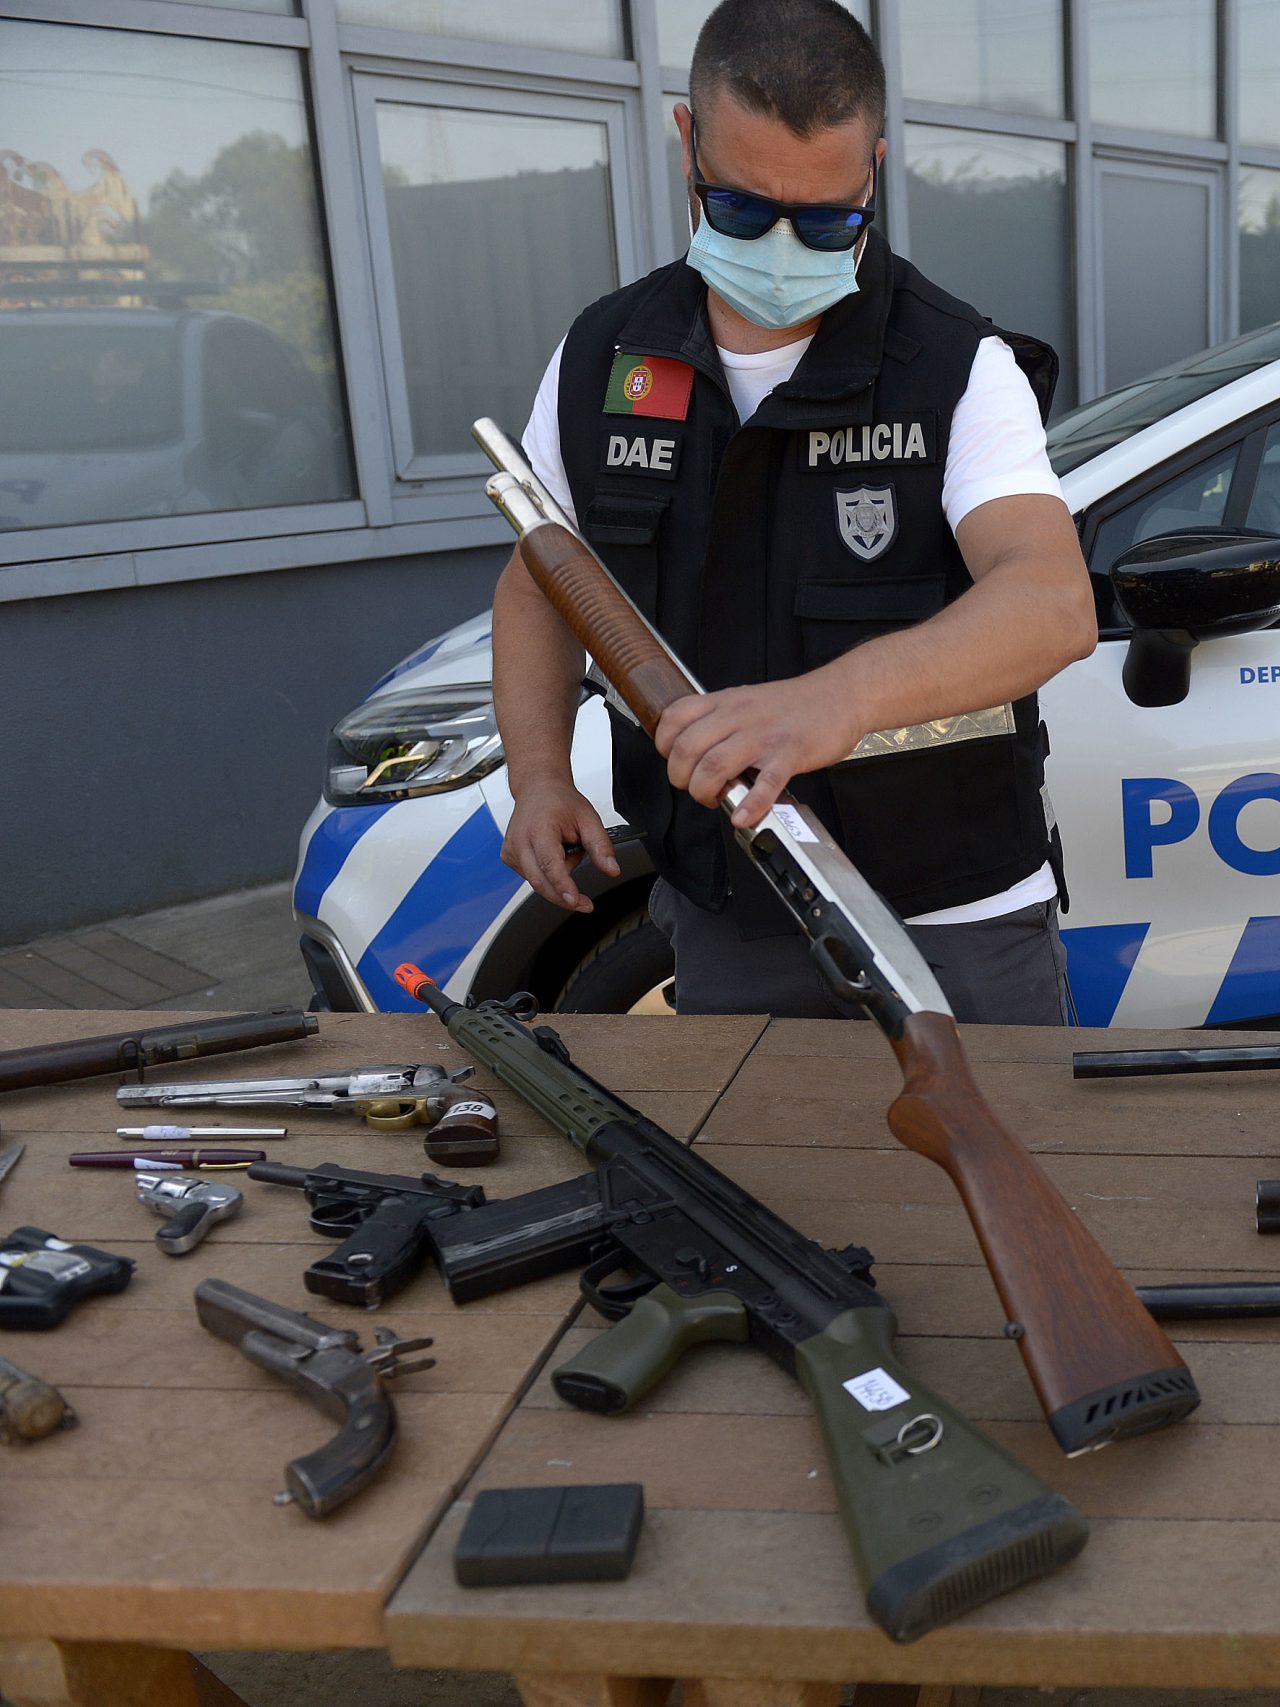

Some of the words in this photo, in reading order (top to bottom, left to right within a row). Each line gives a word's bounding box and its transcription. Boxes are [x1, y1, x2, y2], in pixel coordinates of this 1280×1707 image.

[606, 435, 676, 471] DAE
[808, 422, 927, 467] POLICIA
[454, 1103, 483, 1113] 138
